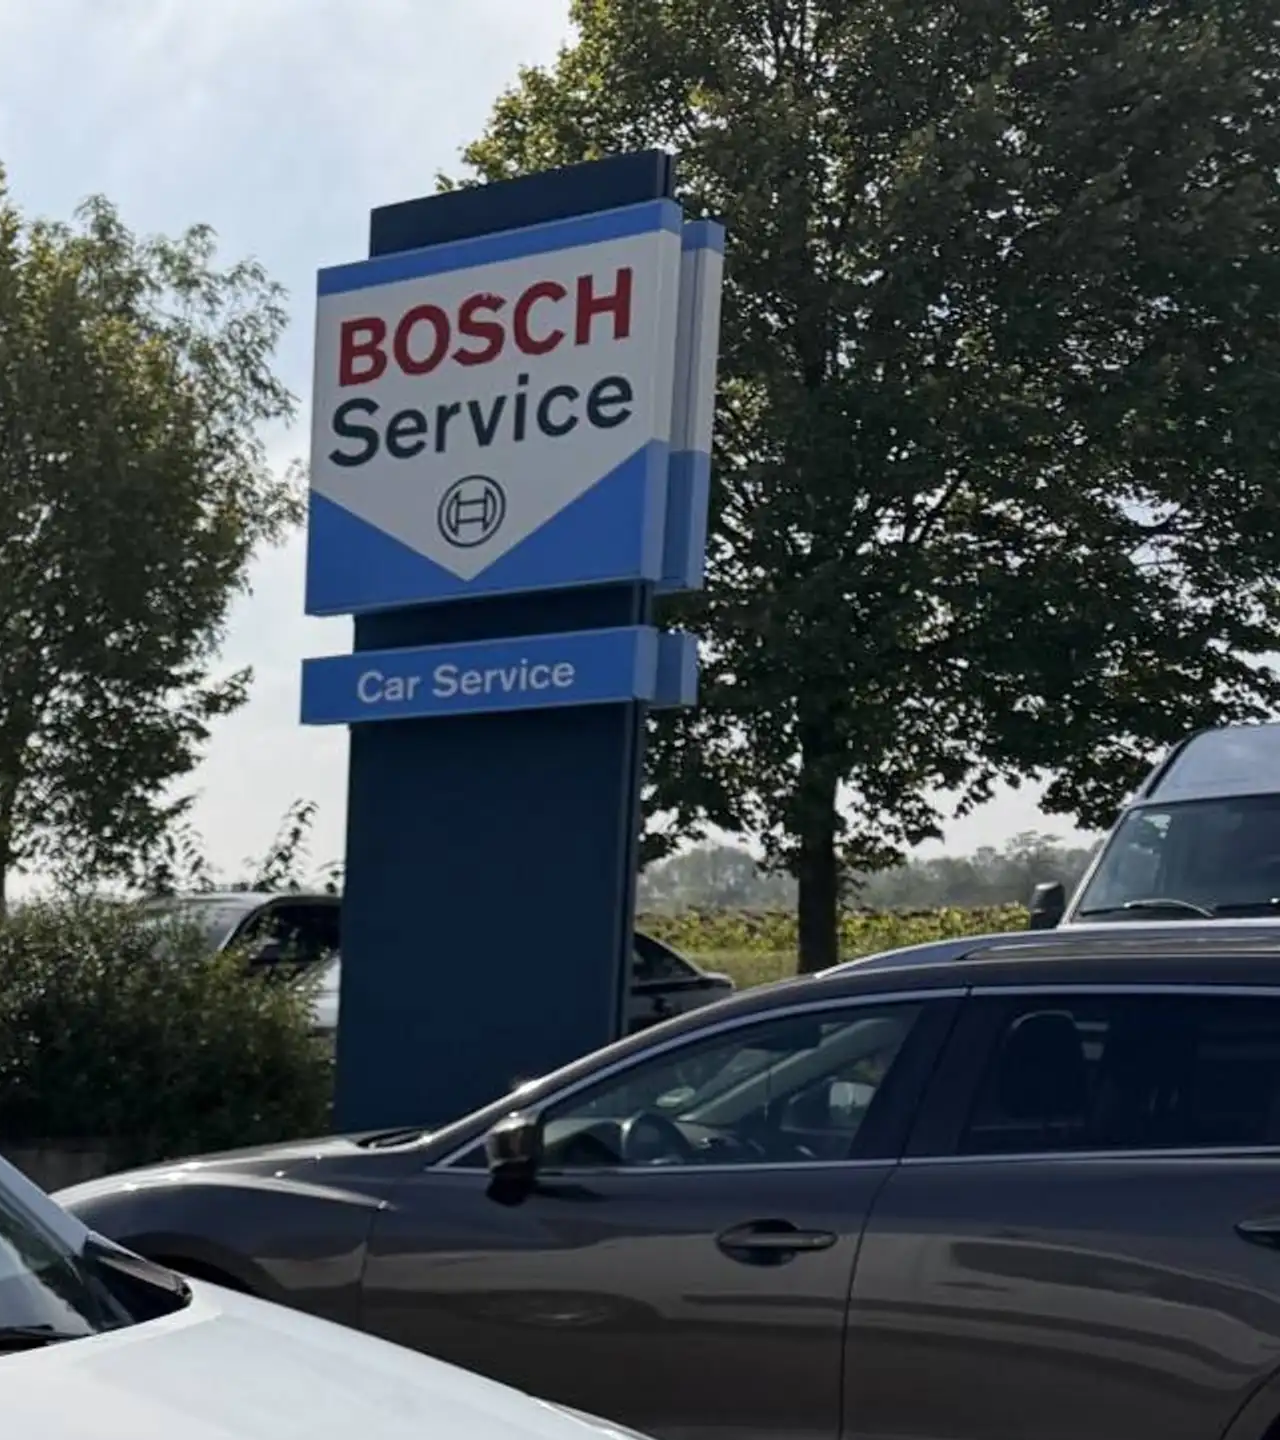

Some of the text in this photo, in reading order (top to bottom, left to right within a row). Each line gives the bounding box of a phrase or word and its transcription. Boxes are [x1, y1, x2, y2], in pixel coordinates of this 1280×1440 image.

[339, 267, 632, 387] BOSCH
[329, 373, 634, 467] Service
[357, 658, 576, 704] Car Service
